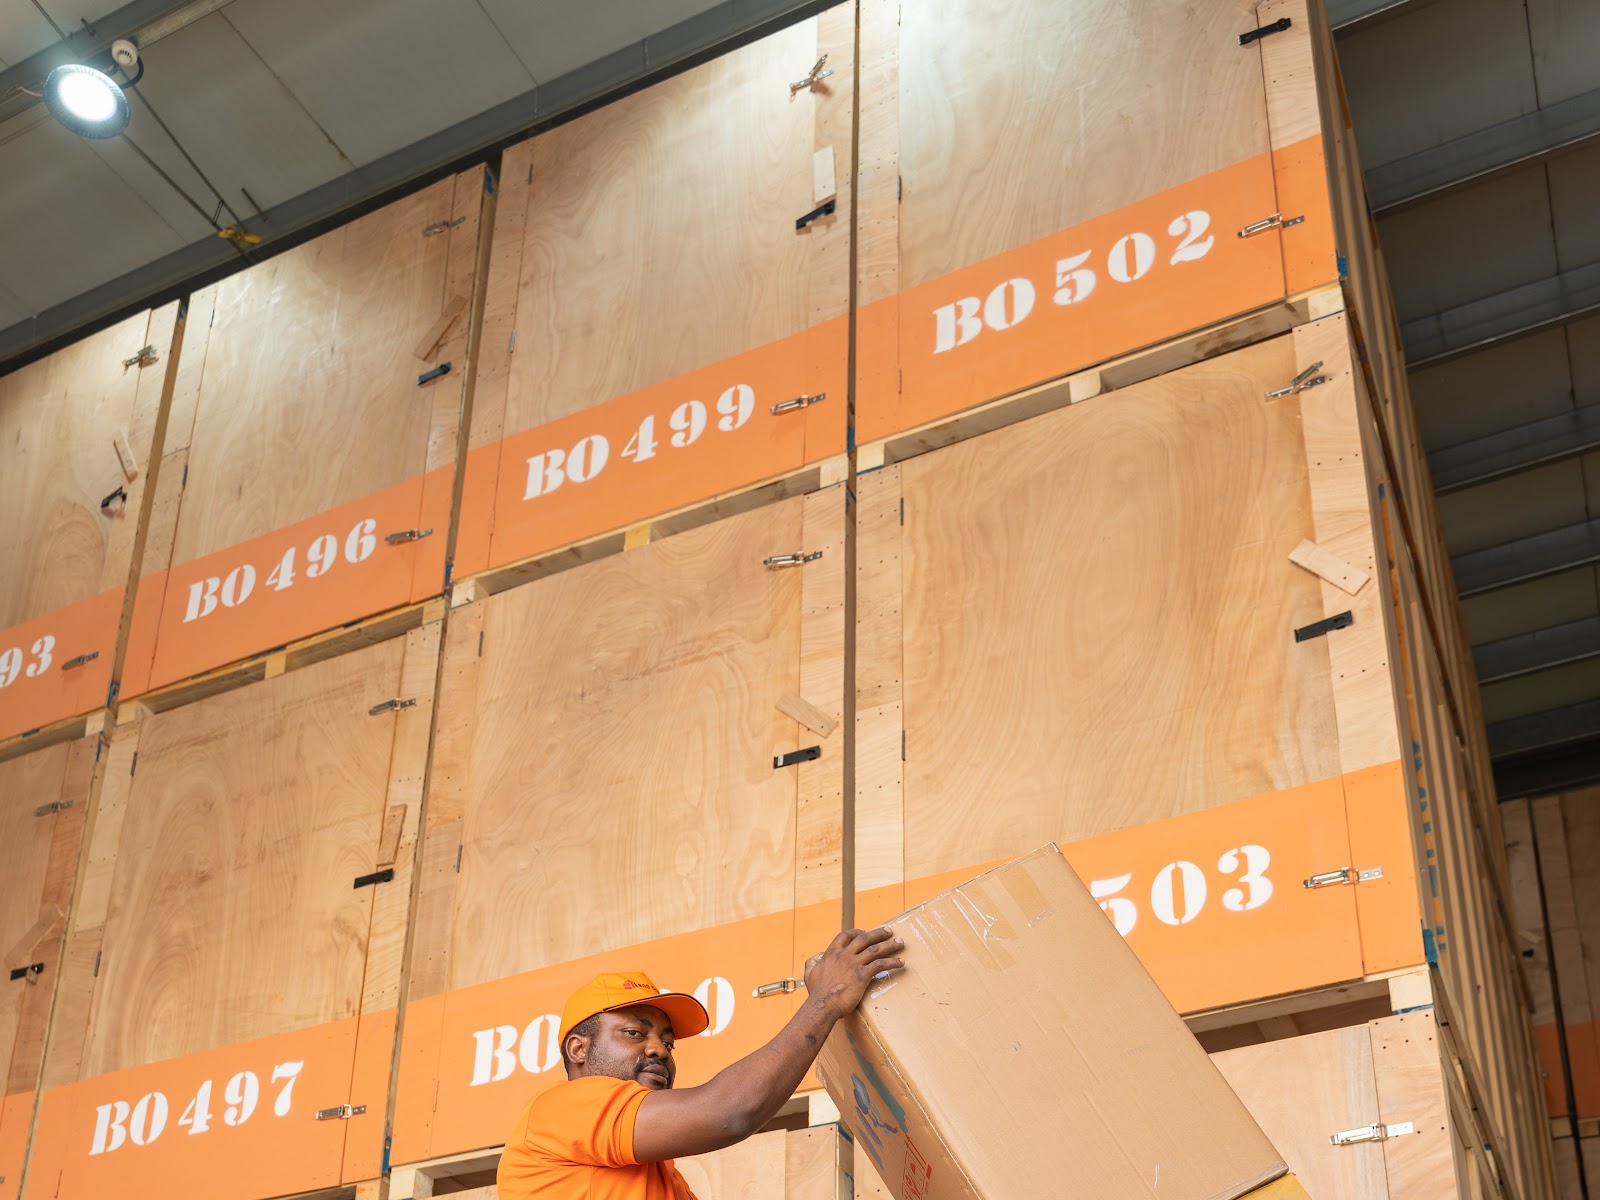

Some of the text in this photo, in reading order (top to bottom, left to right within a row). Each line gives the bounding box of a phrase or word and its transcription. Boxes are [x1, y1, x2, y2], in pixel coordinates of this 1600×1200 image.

[933, 211, 1215, 354] BO 502
[523, 385, 754, 500] BO 499
[184, 519, 377, 621] BO 496
[90, 1061, 304, 1155] BO 497
